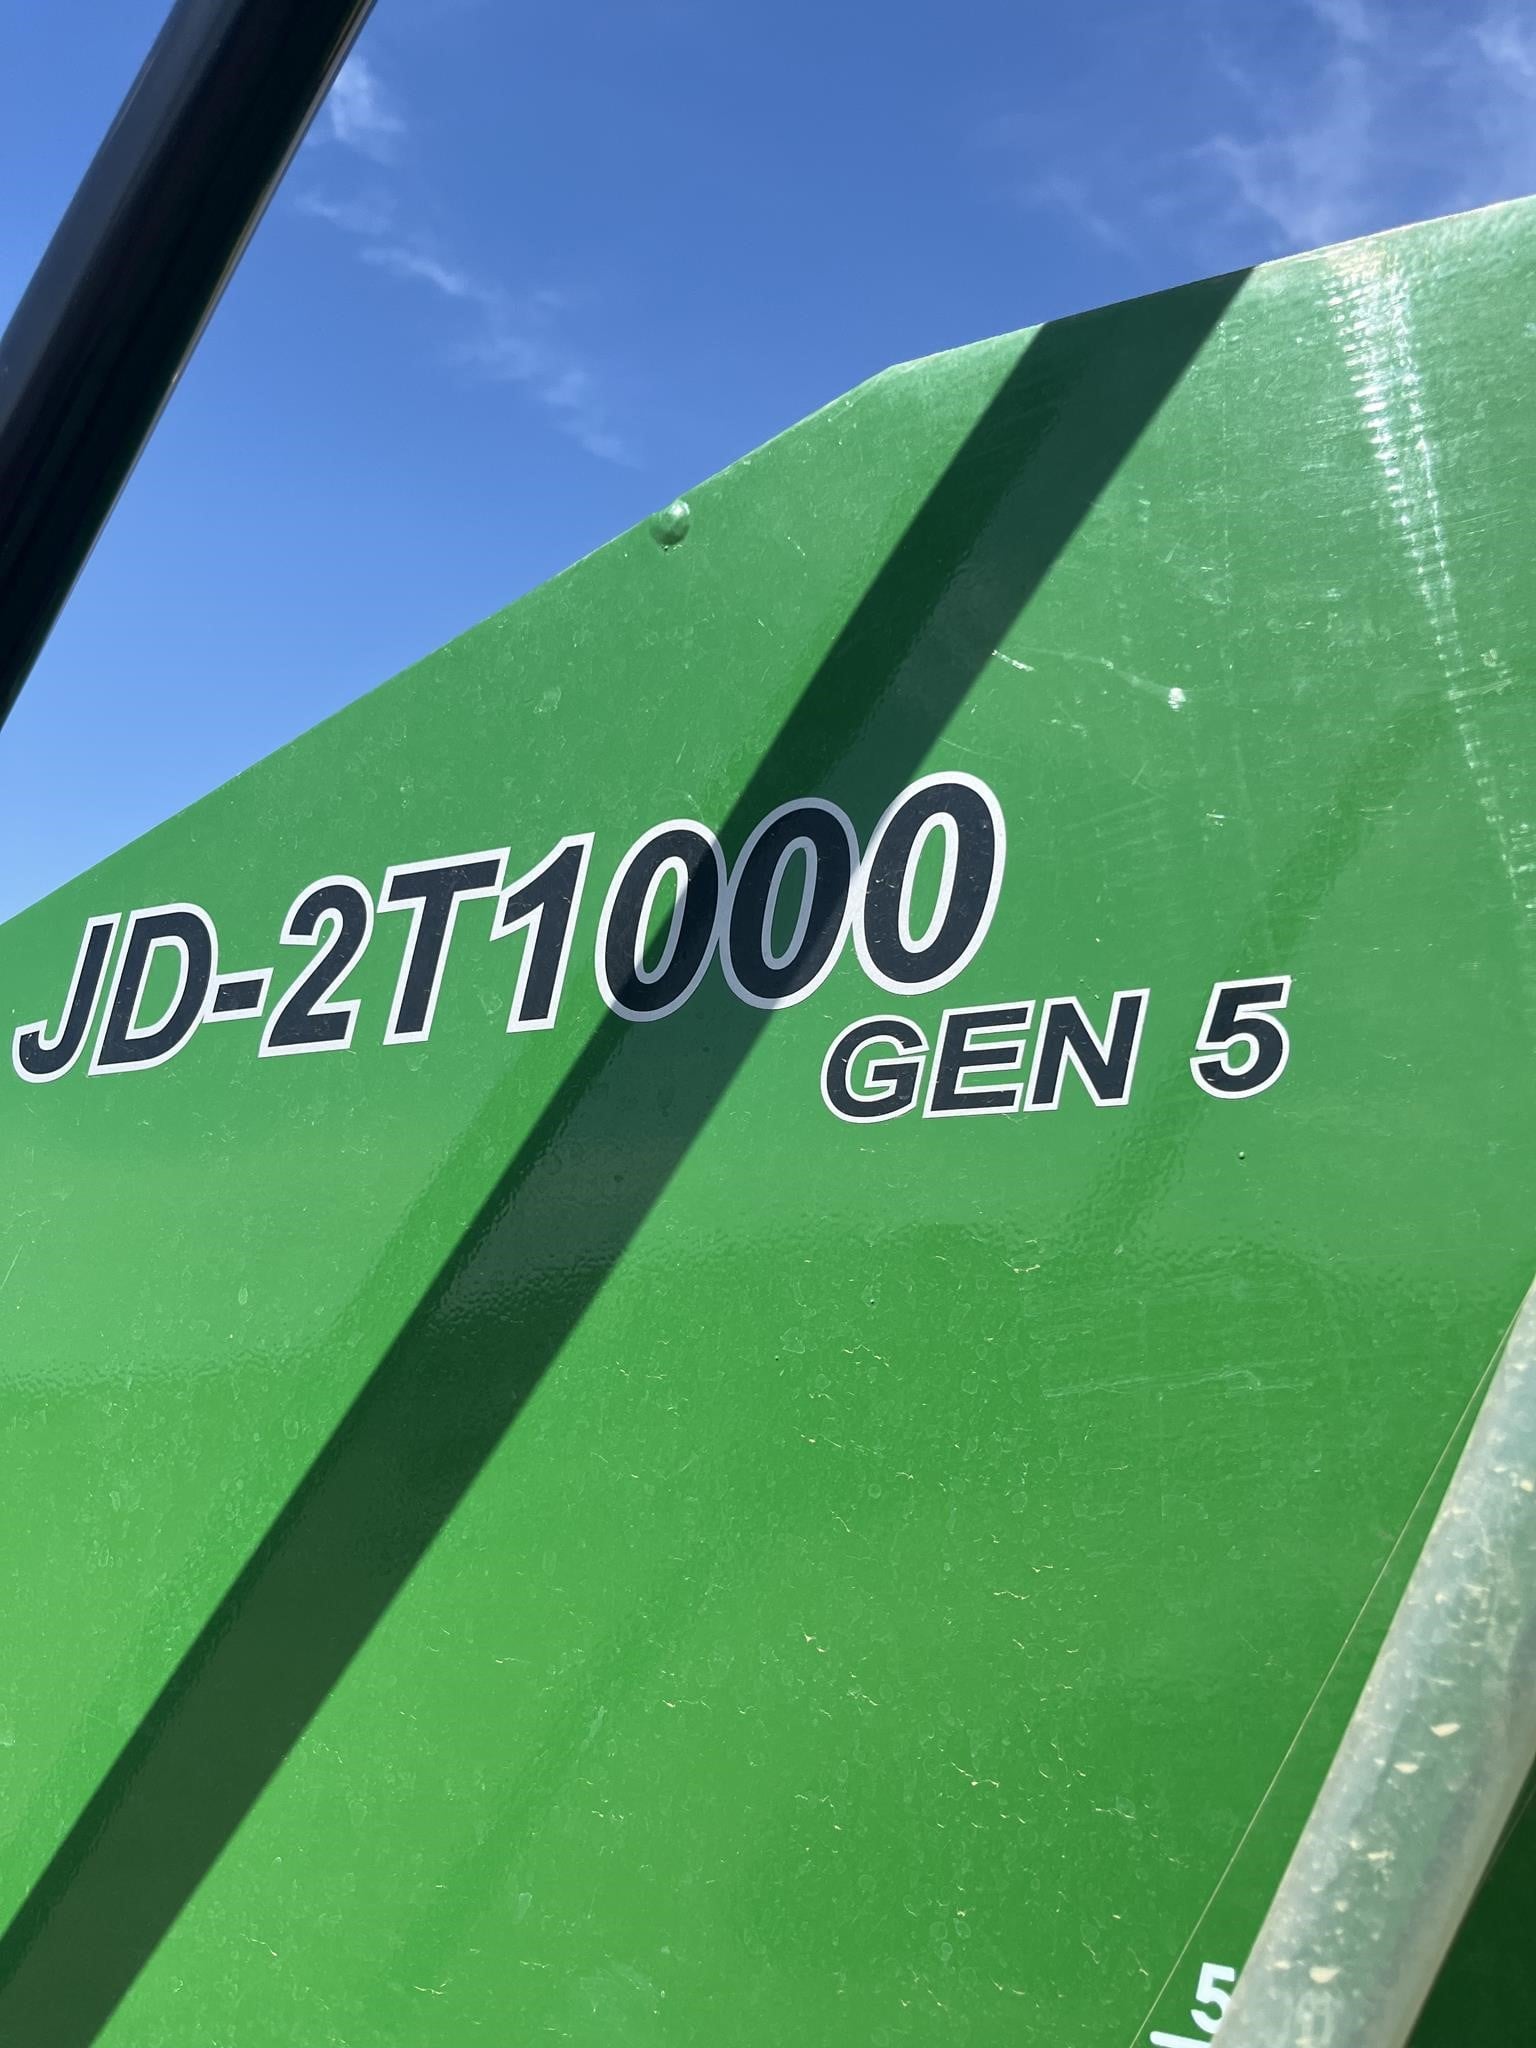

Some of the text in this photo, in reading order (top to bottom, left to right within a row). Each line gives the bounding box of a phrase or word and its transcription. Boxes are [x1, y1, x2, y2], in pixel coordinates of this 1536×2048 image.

[12, 771, 1006, 1084] JD-2T1000
[820, 975, 1291, 1123] GEN 5
